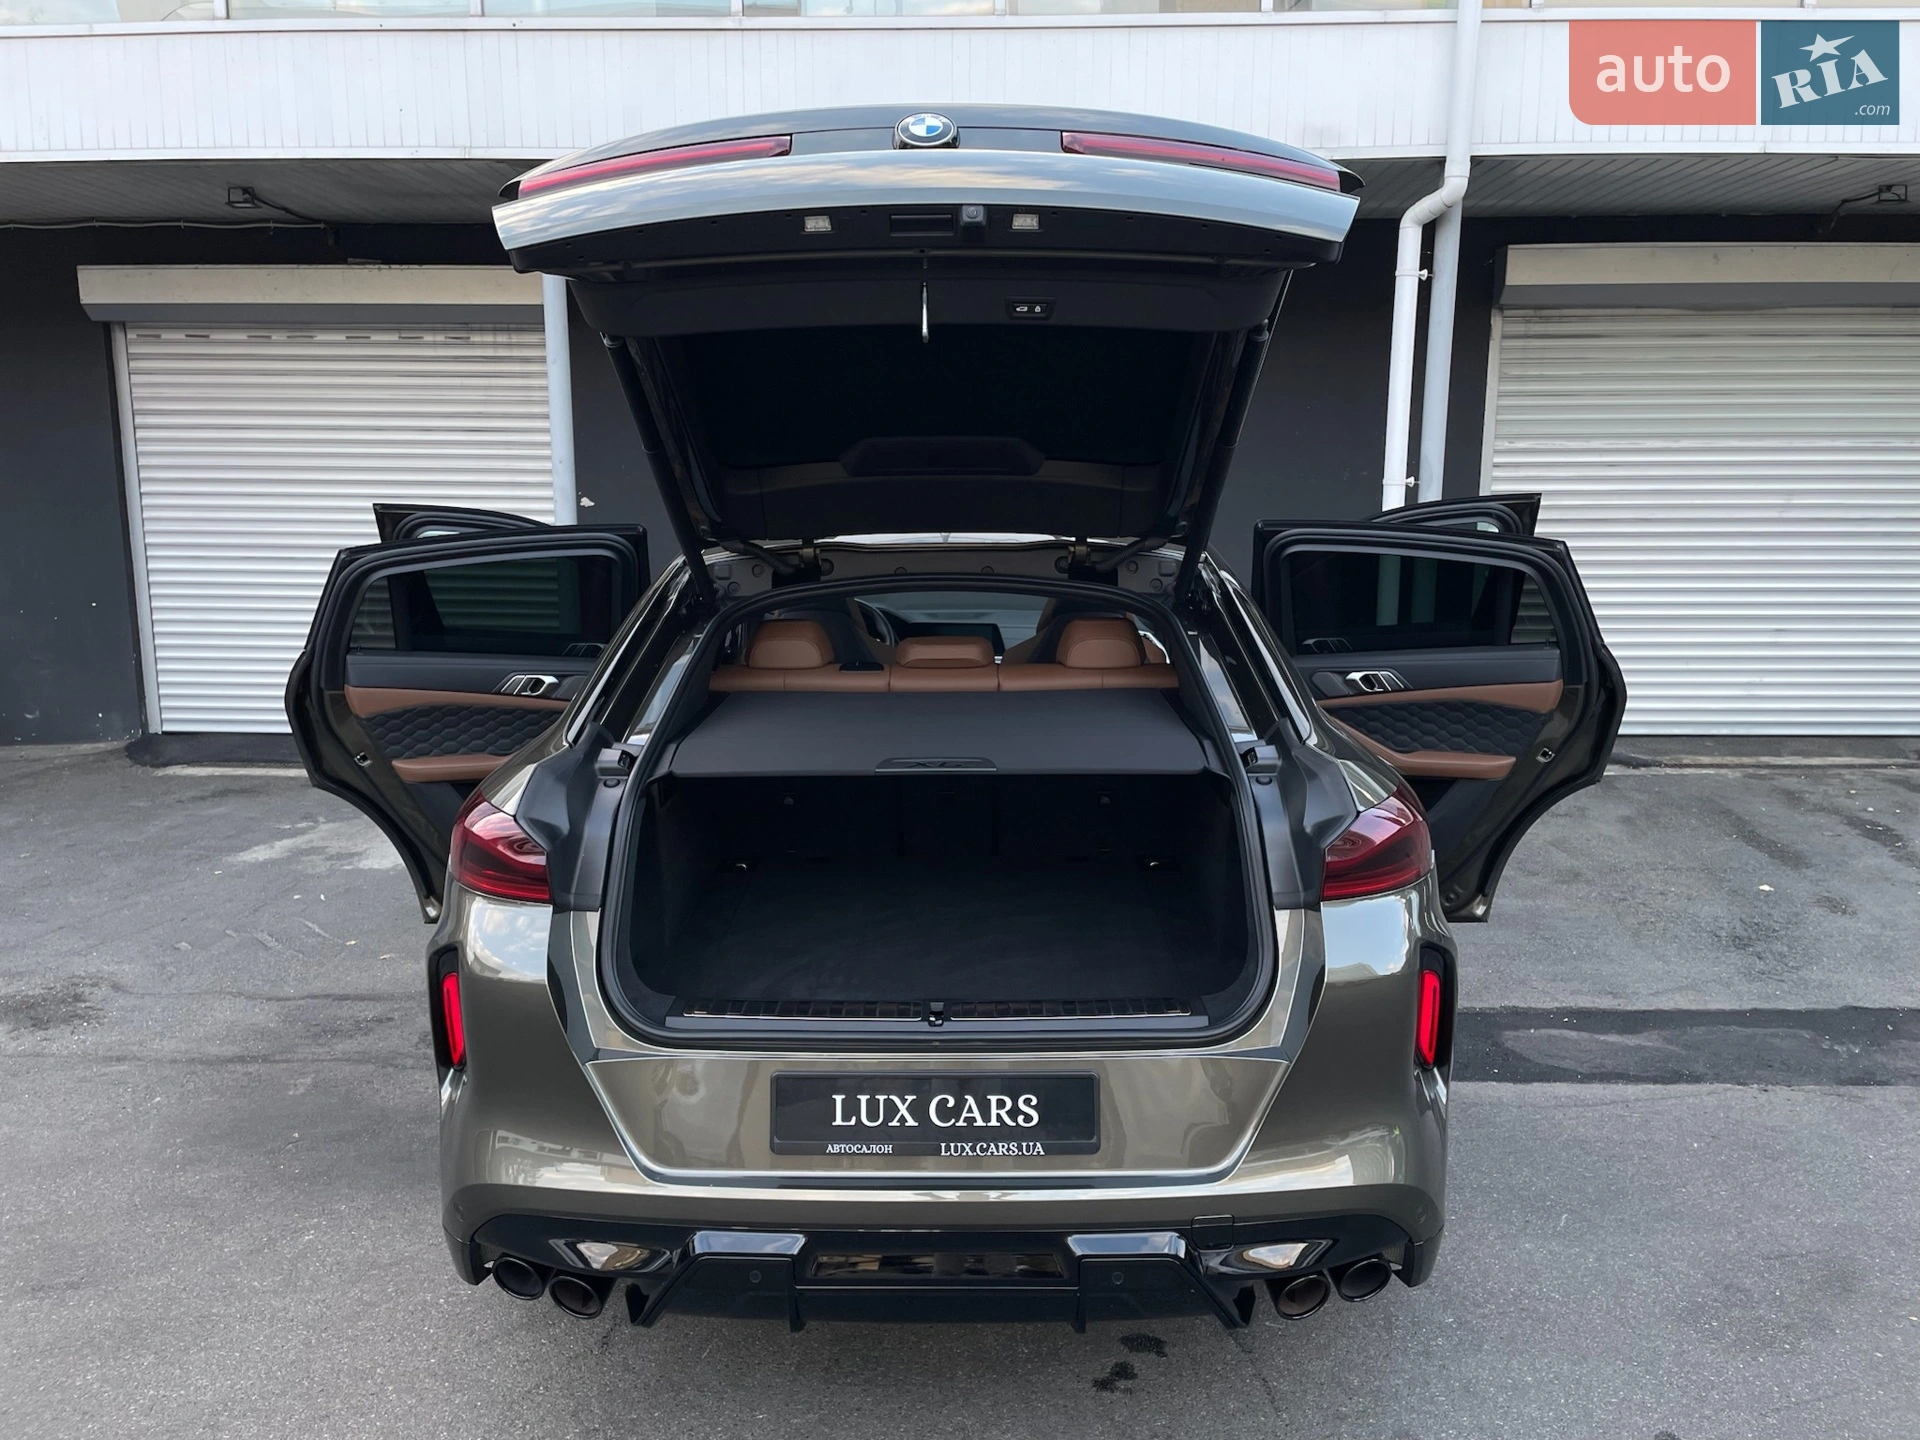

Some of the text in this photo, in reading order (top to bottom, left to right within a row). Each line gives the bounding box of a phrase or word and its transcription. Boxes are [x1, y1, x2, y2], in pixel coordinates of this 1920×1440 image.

[831, 1094, 1040, 1128] LUX CARS
[825, 1143, 893, 1154] АВТОСАЛОН
[940, 1142, 1046, 1156] LUX.CARS.UA
